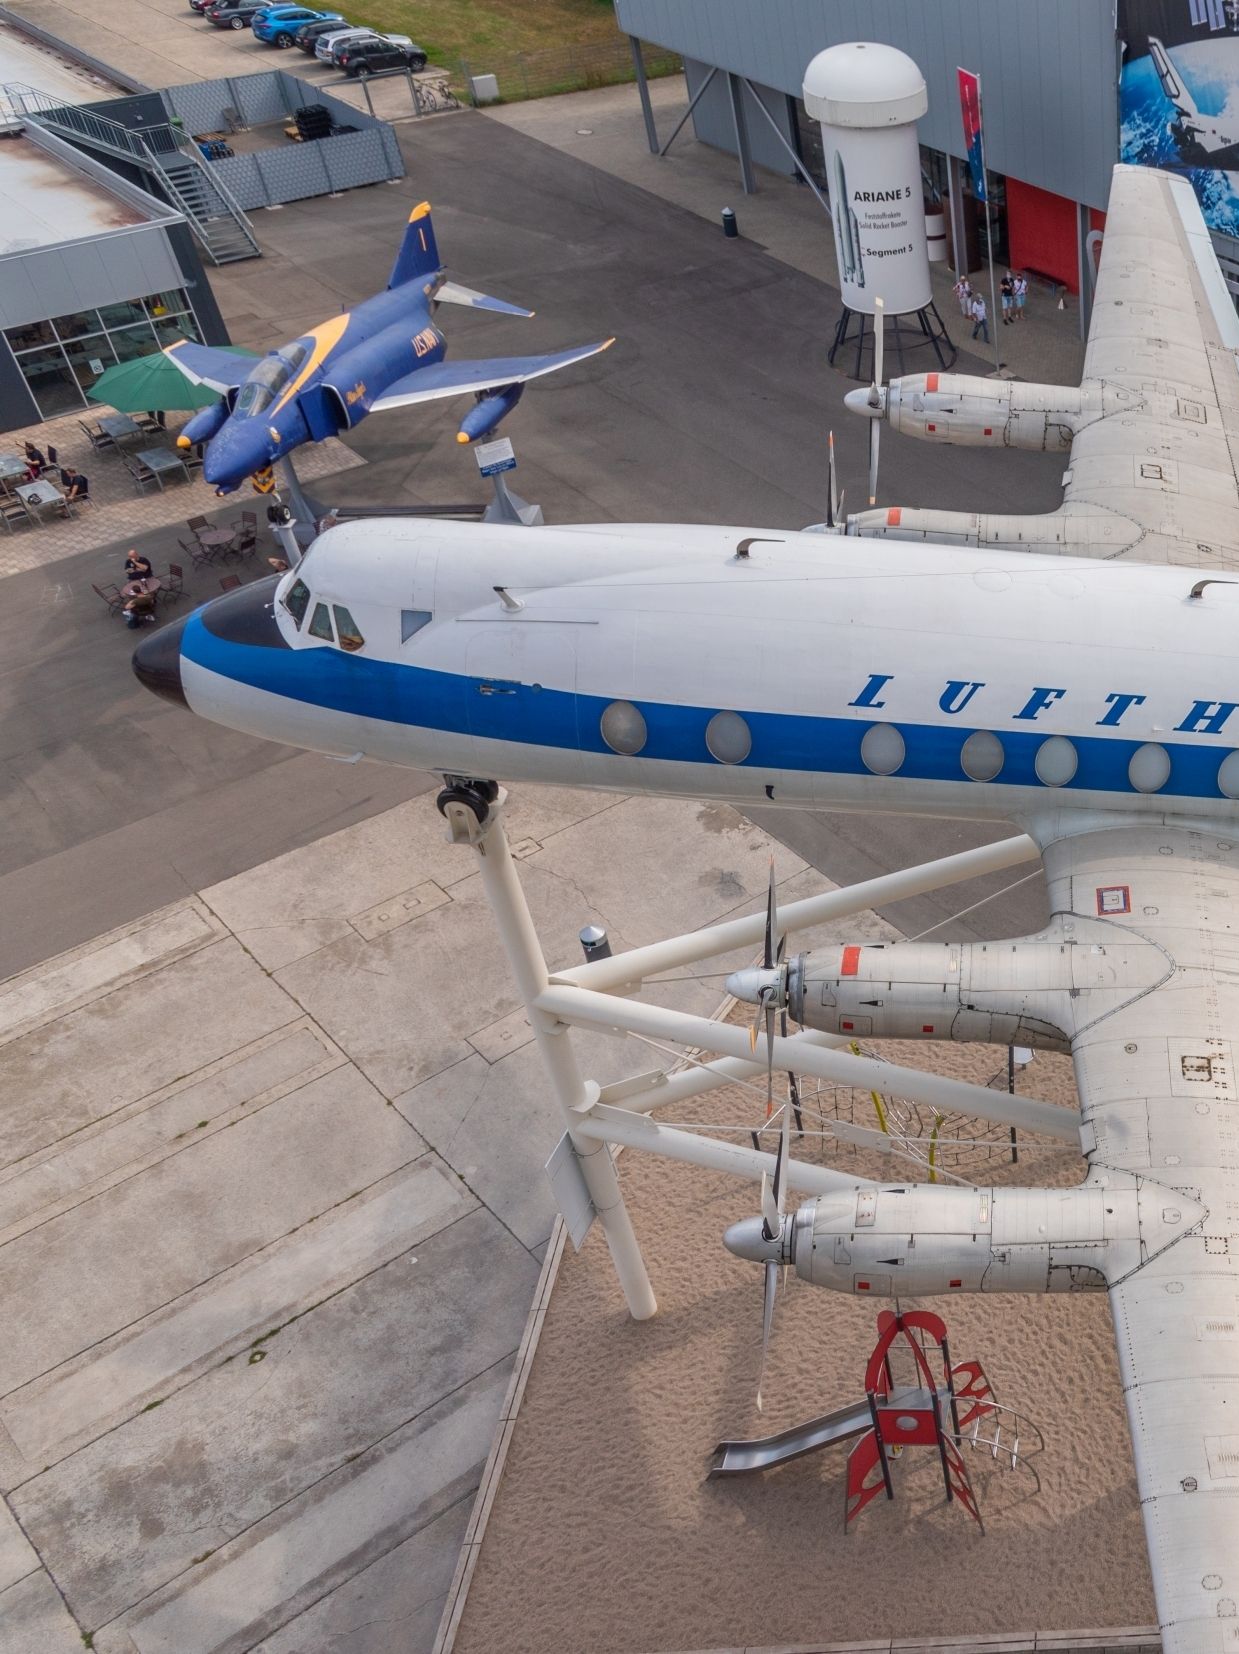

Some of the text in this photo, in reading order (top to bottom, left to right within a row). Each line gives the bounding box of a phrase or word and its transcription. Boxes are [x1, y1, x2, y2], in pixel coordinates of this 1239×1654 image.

[854, 186, 911, 203] ARIANE 5
[873, 222, 890, 230] Rocket
[891, 220, 908, 229] Booster
[866, 243, 913, 258] Segment 5
